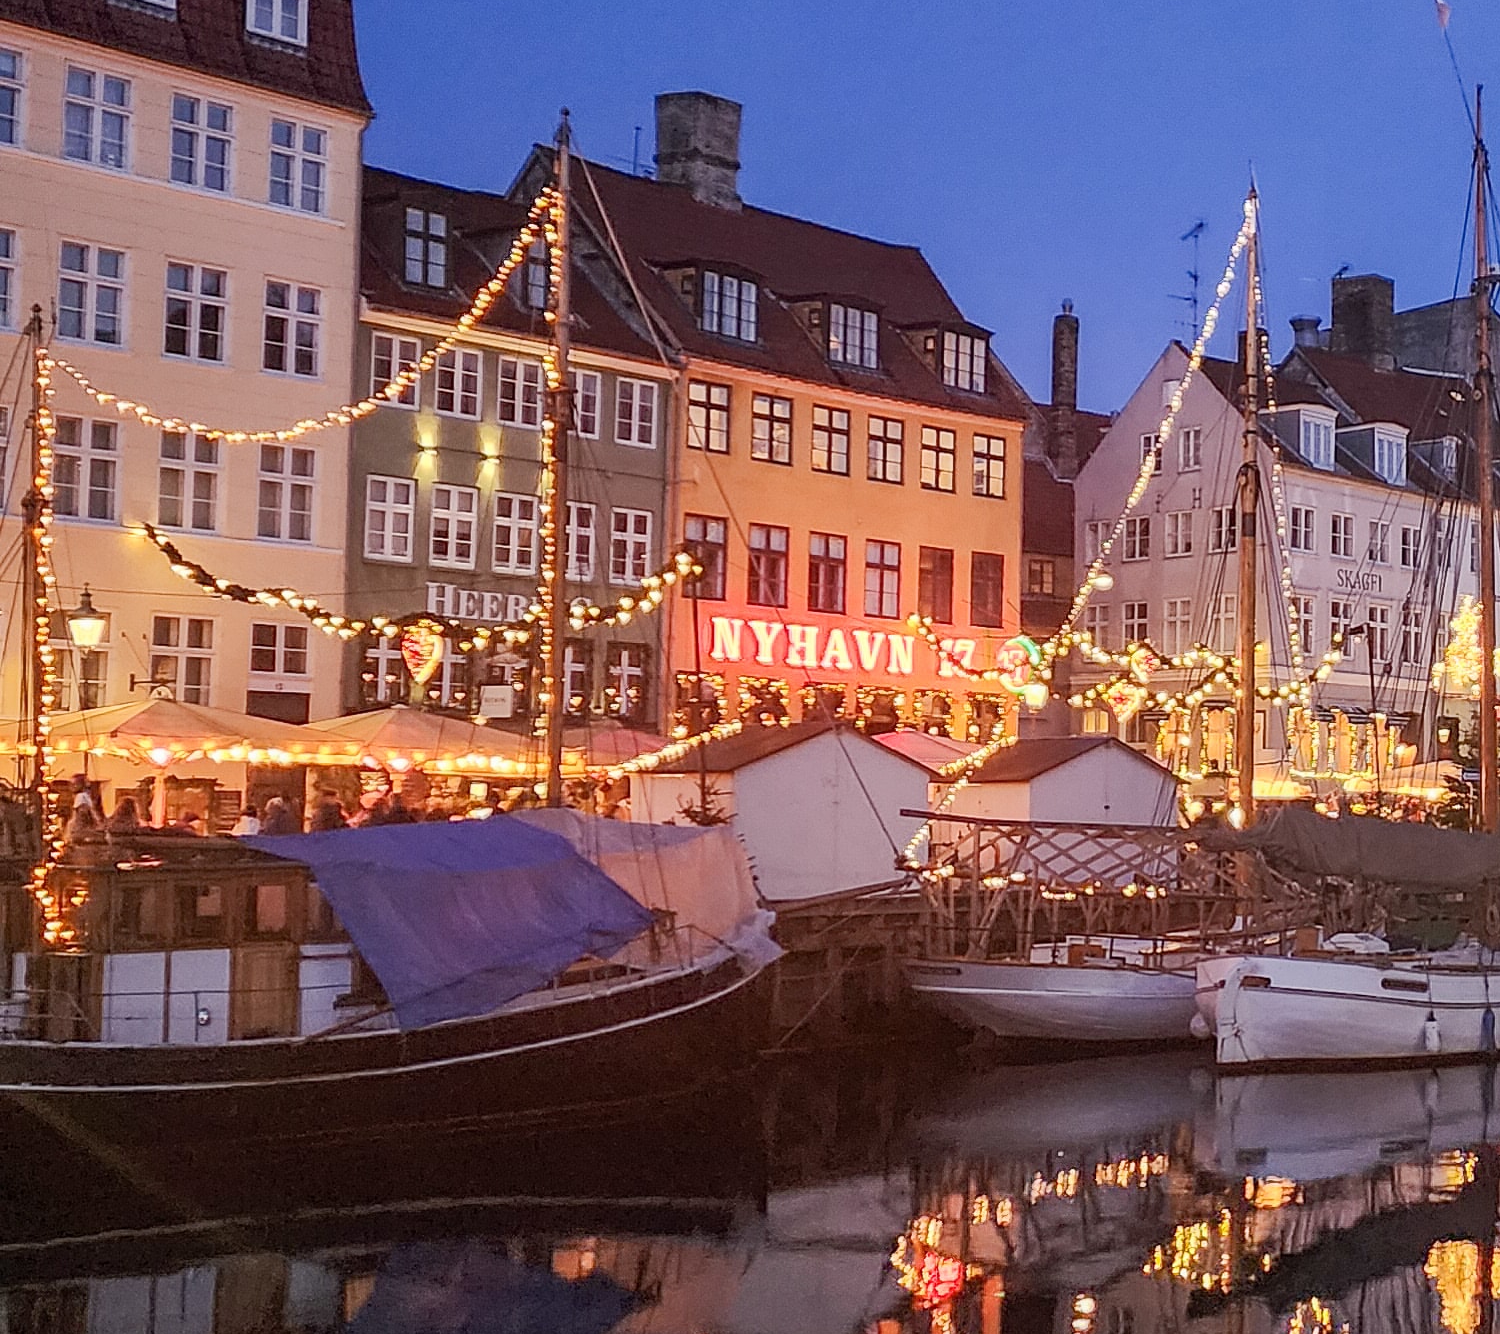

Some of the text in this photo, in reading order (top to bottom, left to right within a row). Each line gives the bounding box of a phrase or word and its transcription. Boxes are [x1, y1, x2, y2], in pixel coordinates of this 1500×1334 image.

[426, 581, 593, 625] HEER
[711, 616, 977, 677] NYHAVN 17
